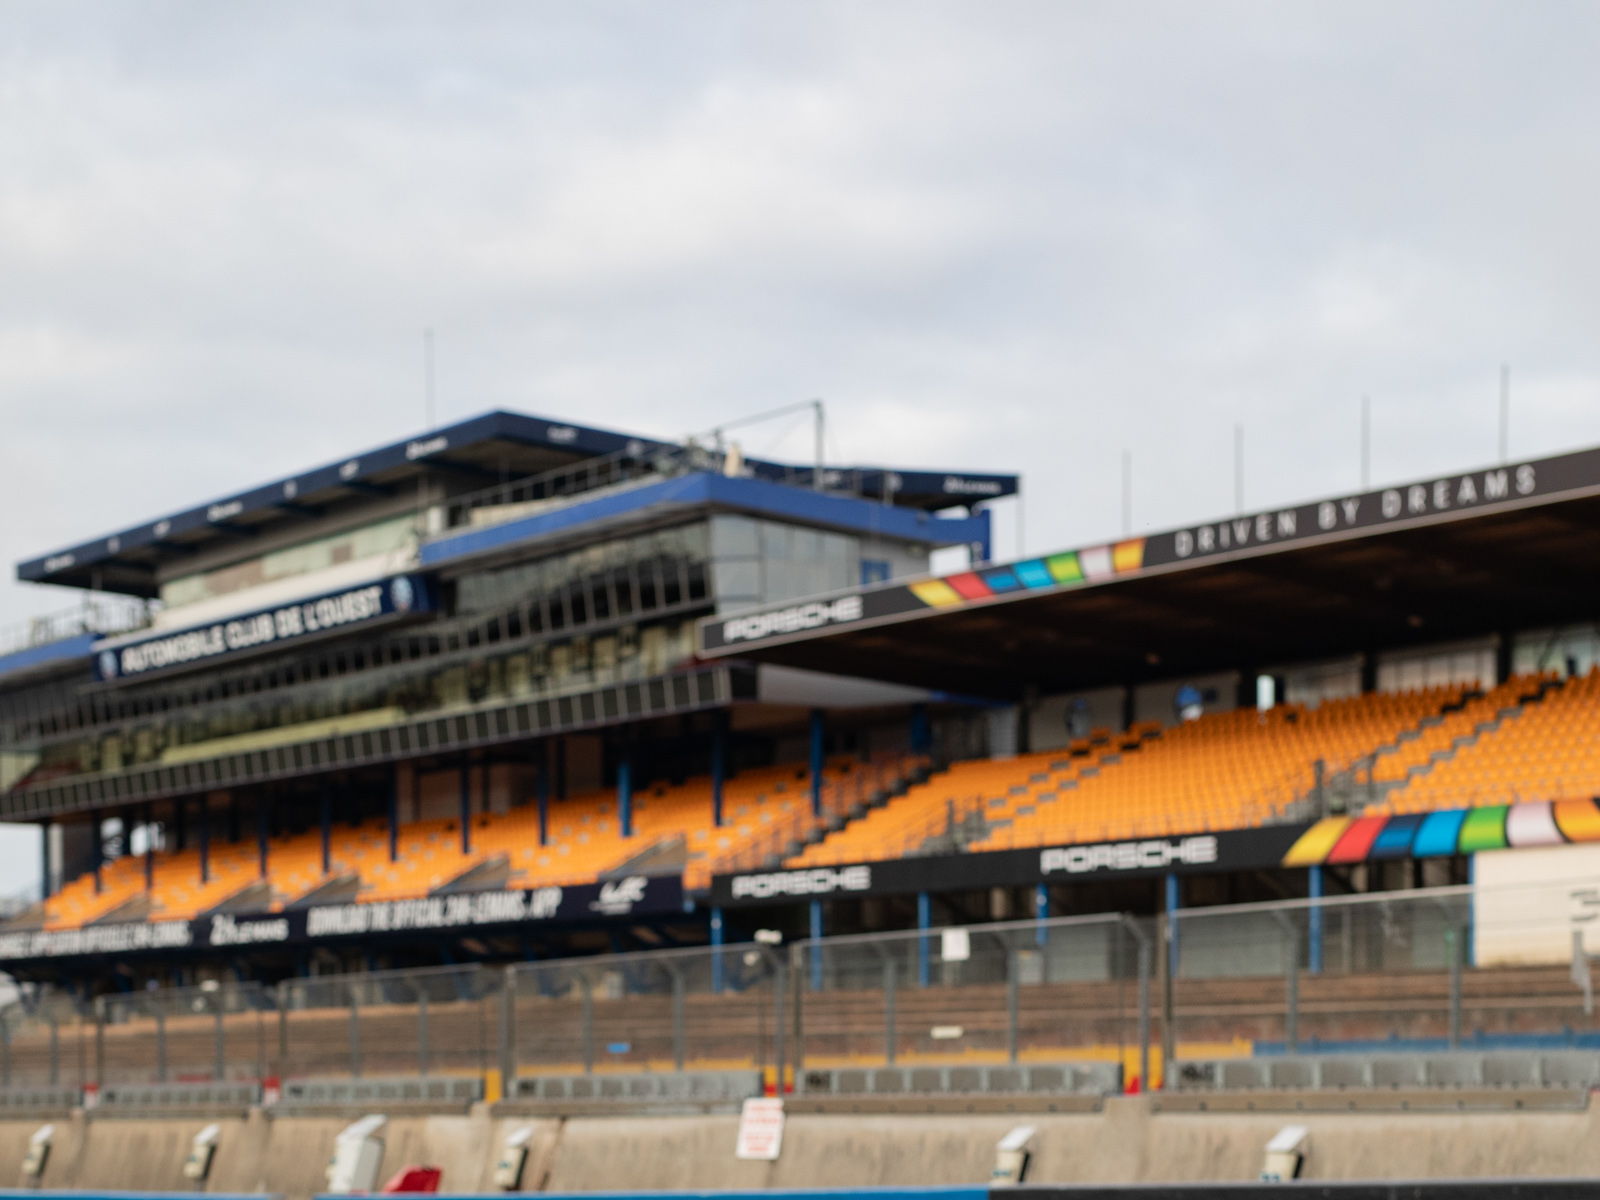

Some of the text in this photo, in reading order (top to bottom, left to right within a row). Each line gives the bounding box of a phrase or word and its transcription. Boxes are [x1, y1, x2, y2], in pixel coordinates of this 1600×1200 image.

[1174, 463, 1536, 558] DRIVEN BY DREAMS
[121, 624, 225, 675] AUTOMOBILE
[224, 612, 276, 649] CLUB
[275, 605, 304, 638] DE
[723, 595, 863, 643] PORSCHE
[1040, 836, 1218, 875] PORSCHE
[732, 866, 871, 899] PORSCHE
